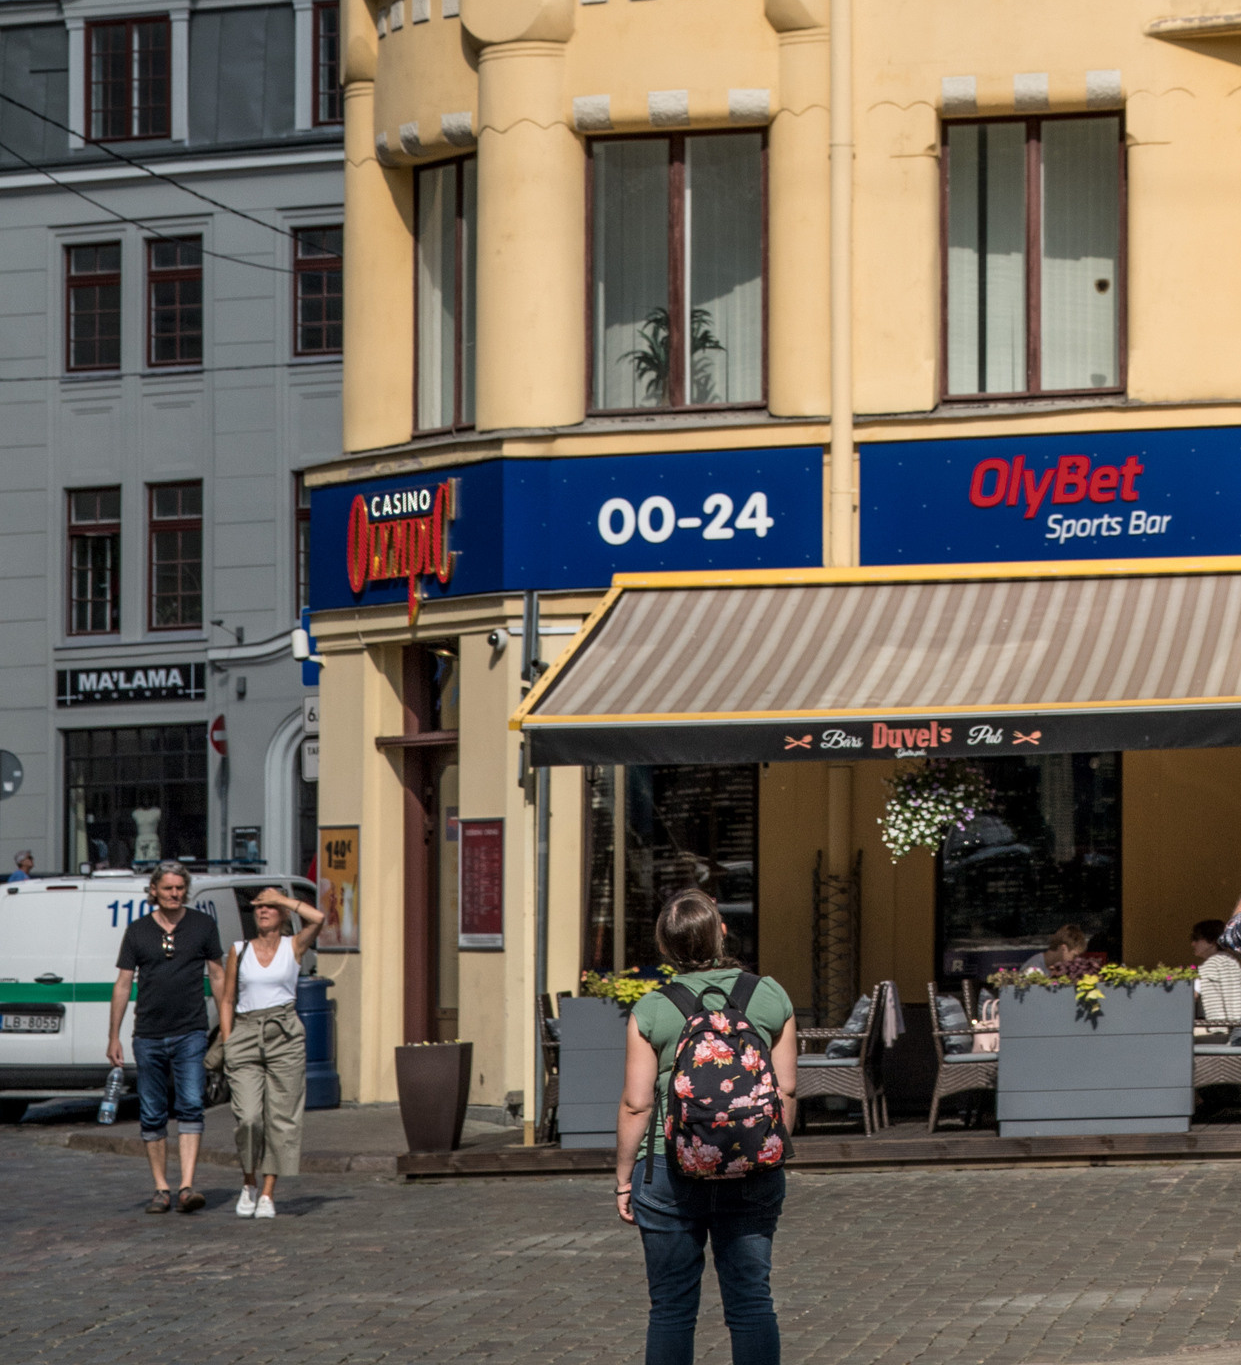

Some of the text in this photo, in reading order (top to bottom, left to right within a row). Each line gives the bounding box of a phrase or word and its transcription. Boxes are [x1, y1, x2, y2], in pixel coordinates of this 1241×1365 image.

[371, 488, 431, 517] CASINO
[969, 454, 1144, 519] OlyBet
[597, 491, 774, 546] 00-24
[1045, 510, 1172, 545] Sports Bar
[871, 721, 952, 749] Duvel's
[966, 725, 1003, 746] Pub
